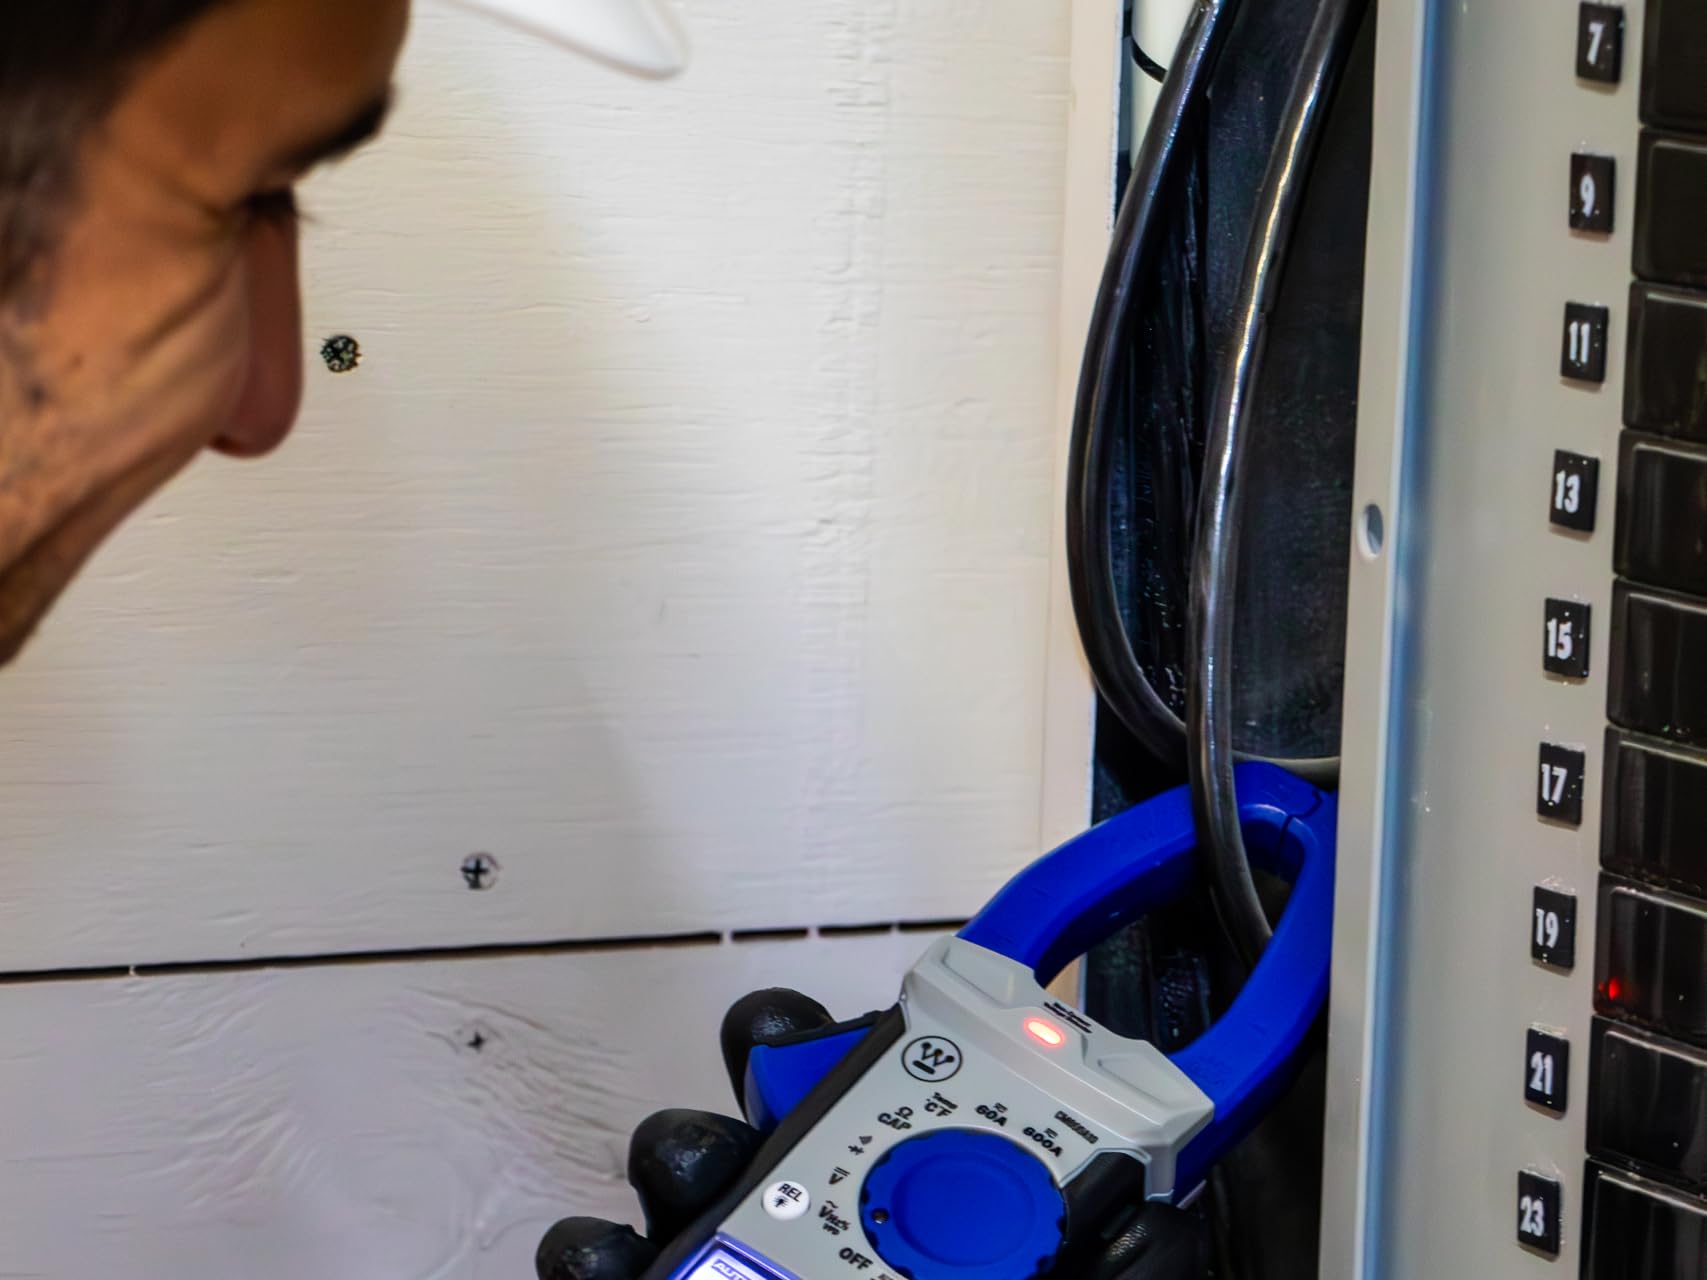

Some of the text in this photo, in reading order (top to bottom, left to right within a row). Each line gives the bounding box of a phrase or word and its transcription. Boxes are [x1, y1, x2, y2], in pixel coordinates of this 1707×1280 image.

[1587, 21, 1606, 65] 7
[1580, 174, 1595, 217] 9
[1569, 321, 1591, 364] 11
[1555, 470, 1580, 513] 13
[1546, 618, 1573, 660] 15
[1540, 762, 1568, 804] 17
[1535, 908, 1559, 948] 19
[1530, 1051, 1553, 1095] 21
[877, 1112, 912, 1131] CAP
[975, 1104, 1007, 1127] 60A
[1021, 1126, 1063, 1158] 600A
[778, 1183, 803, 1202] REL
[1519, 1195, 1545, 1238] 23
[838, 1247, 873, 1270] OFF
